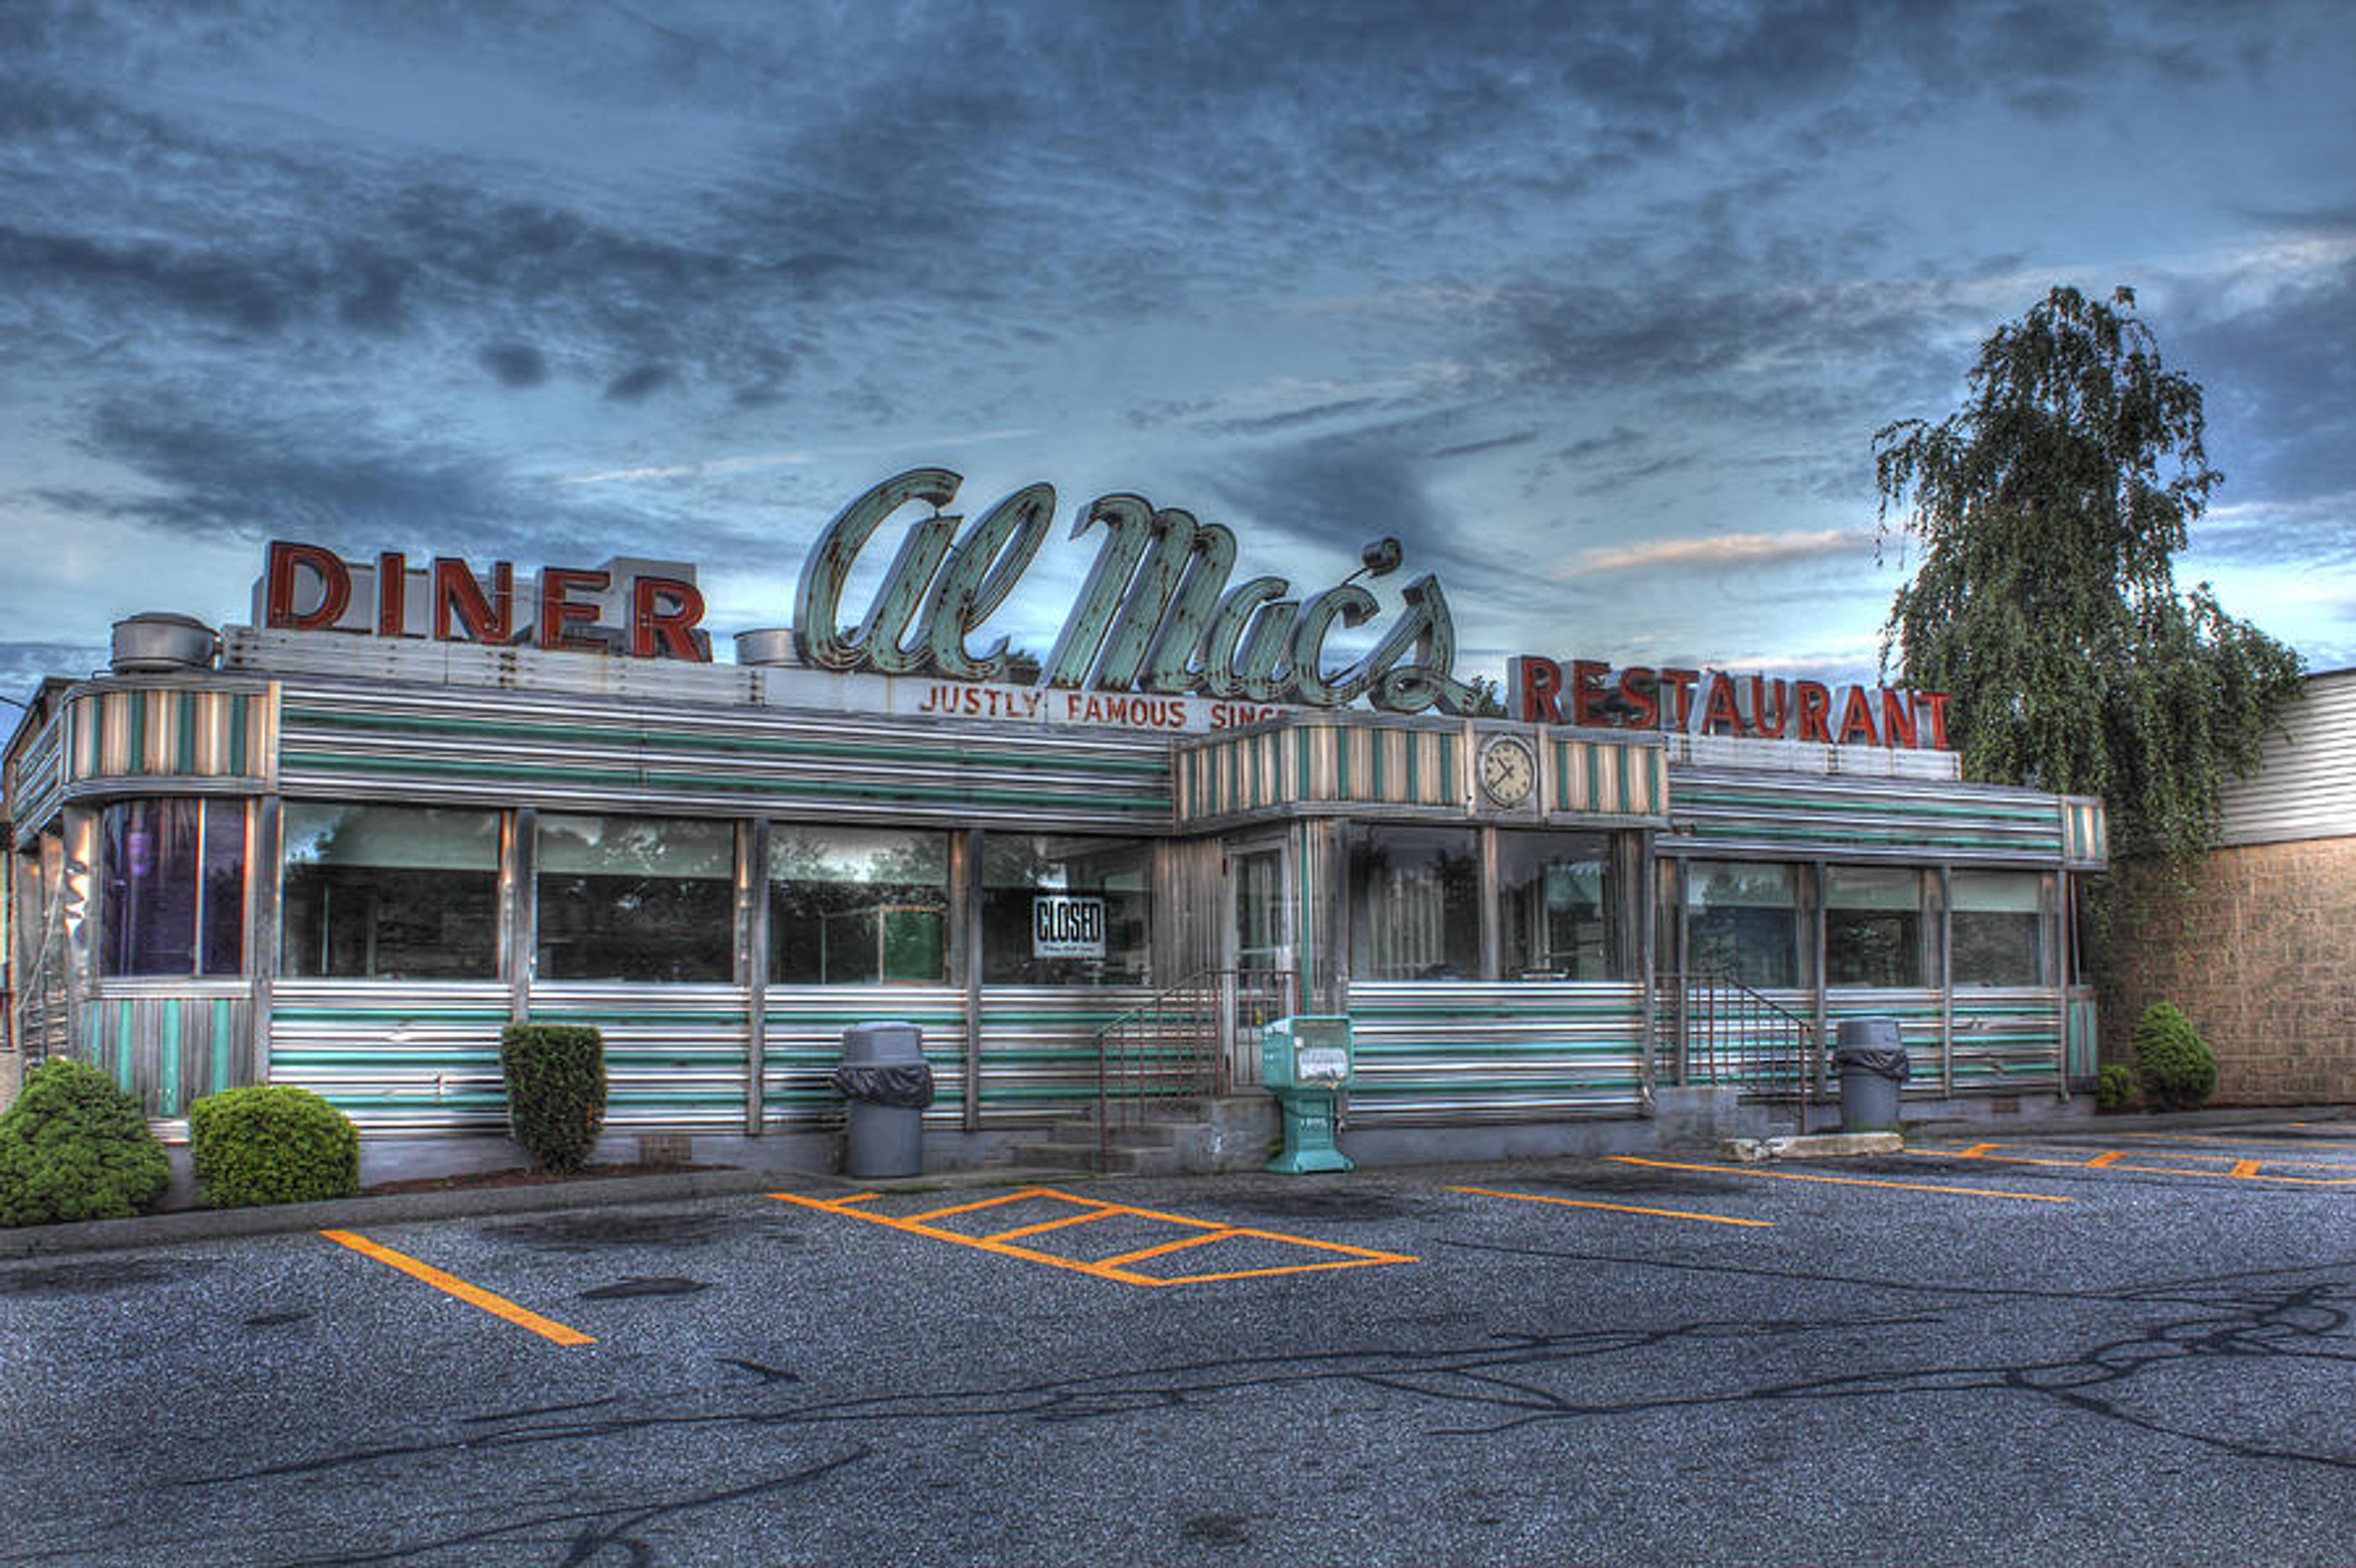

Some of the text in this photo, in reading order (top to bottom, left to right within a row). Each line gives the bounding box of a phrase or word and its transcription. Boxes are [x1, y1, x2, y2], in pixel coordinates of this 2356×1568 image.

[264, 540, 713, 663] DINER
[920, 685, 1042, 718] JUSTLY
[1066, 693, 1188, 729] FAMOUS
[1508, 655, 1954, 751] RESTAURANT
[1036, 901, 1100, 943] CLOSED
